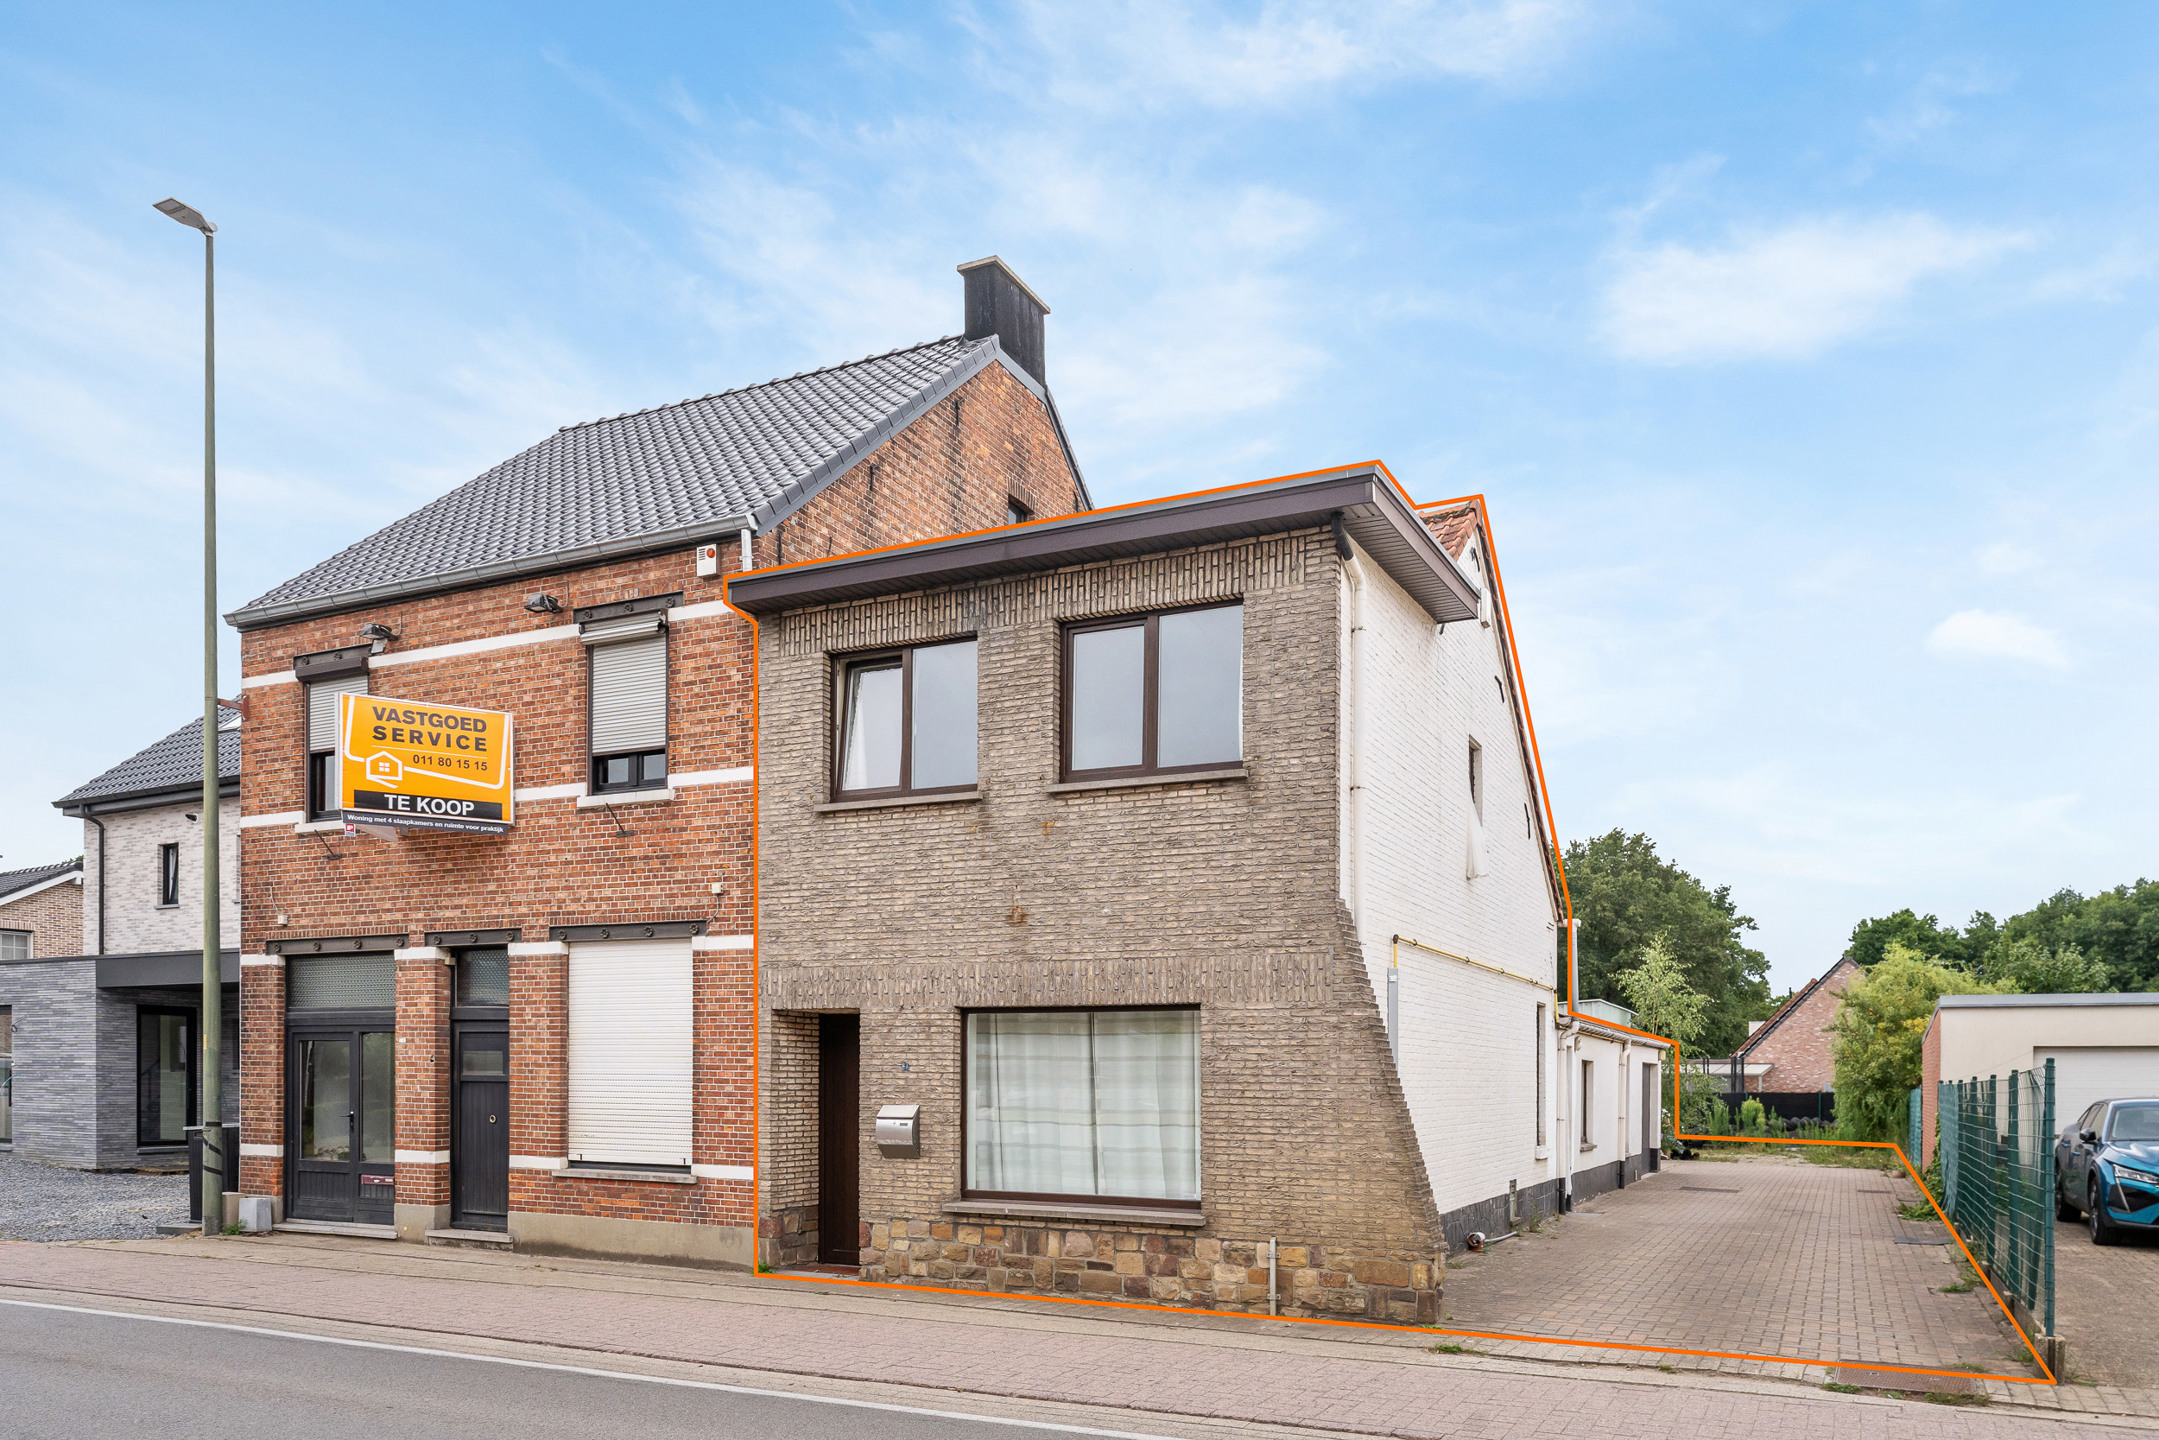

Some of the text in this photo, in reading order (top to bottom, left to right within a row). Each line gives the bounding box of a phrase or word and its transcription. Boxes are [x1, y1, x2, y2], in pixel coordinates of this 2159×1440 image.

[372, 706, 487, 733] VASTGOED
[372, 725, 487, 752] SERVICE
[413, 754, 488, 771] 011 80 15 15
[384, 794, 475, 816] TE KOOP
[347, 814, 373, 822] Woning
[393, 818, 433, 827] slaapkamers
[480, 825, 503, 833] praktijk
